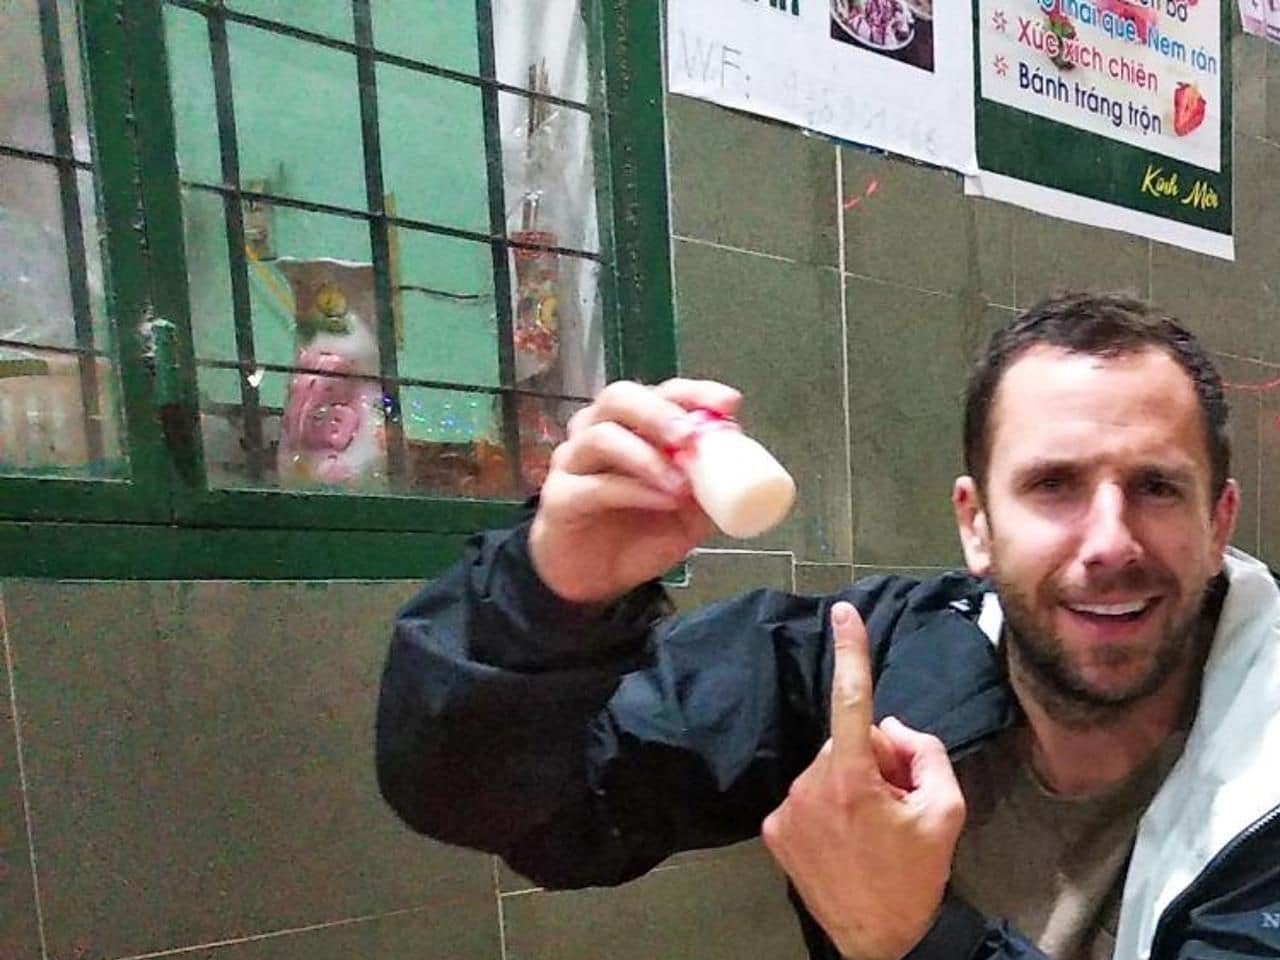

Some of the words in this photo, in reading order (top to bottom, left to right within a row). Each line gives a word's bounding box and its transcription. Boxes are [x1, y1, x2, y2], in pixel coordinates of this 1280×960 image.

[1148, 26, 1187, 61] Nem
[1108, 54, 1159, 93] chiên
[1018, 61, 1070, 103] Bánh
[1075, 82, 1124, 127] tráng
[1128, 101, 1162, 138] trộn
